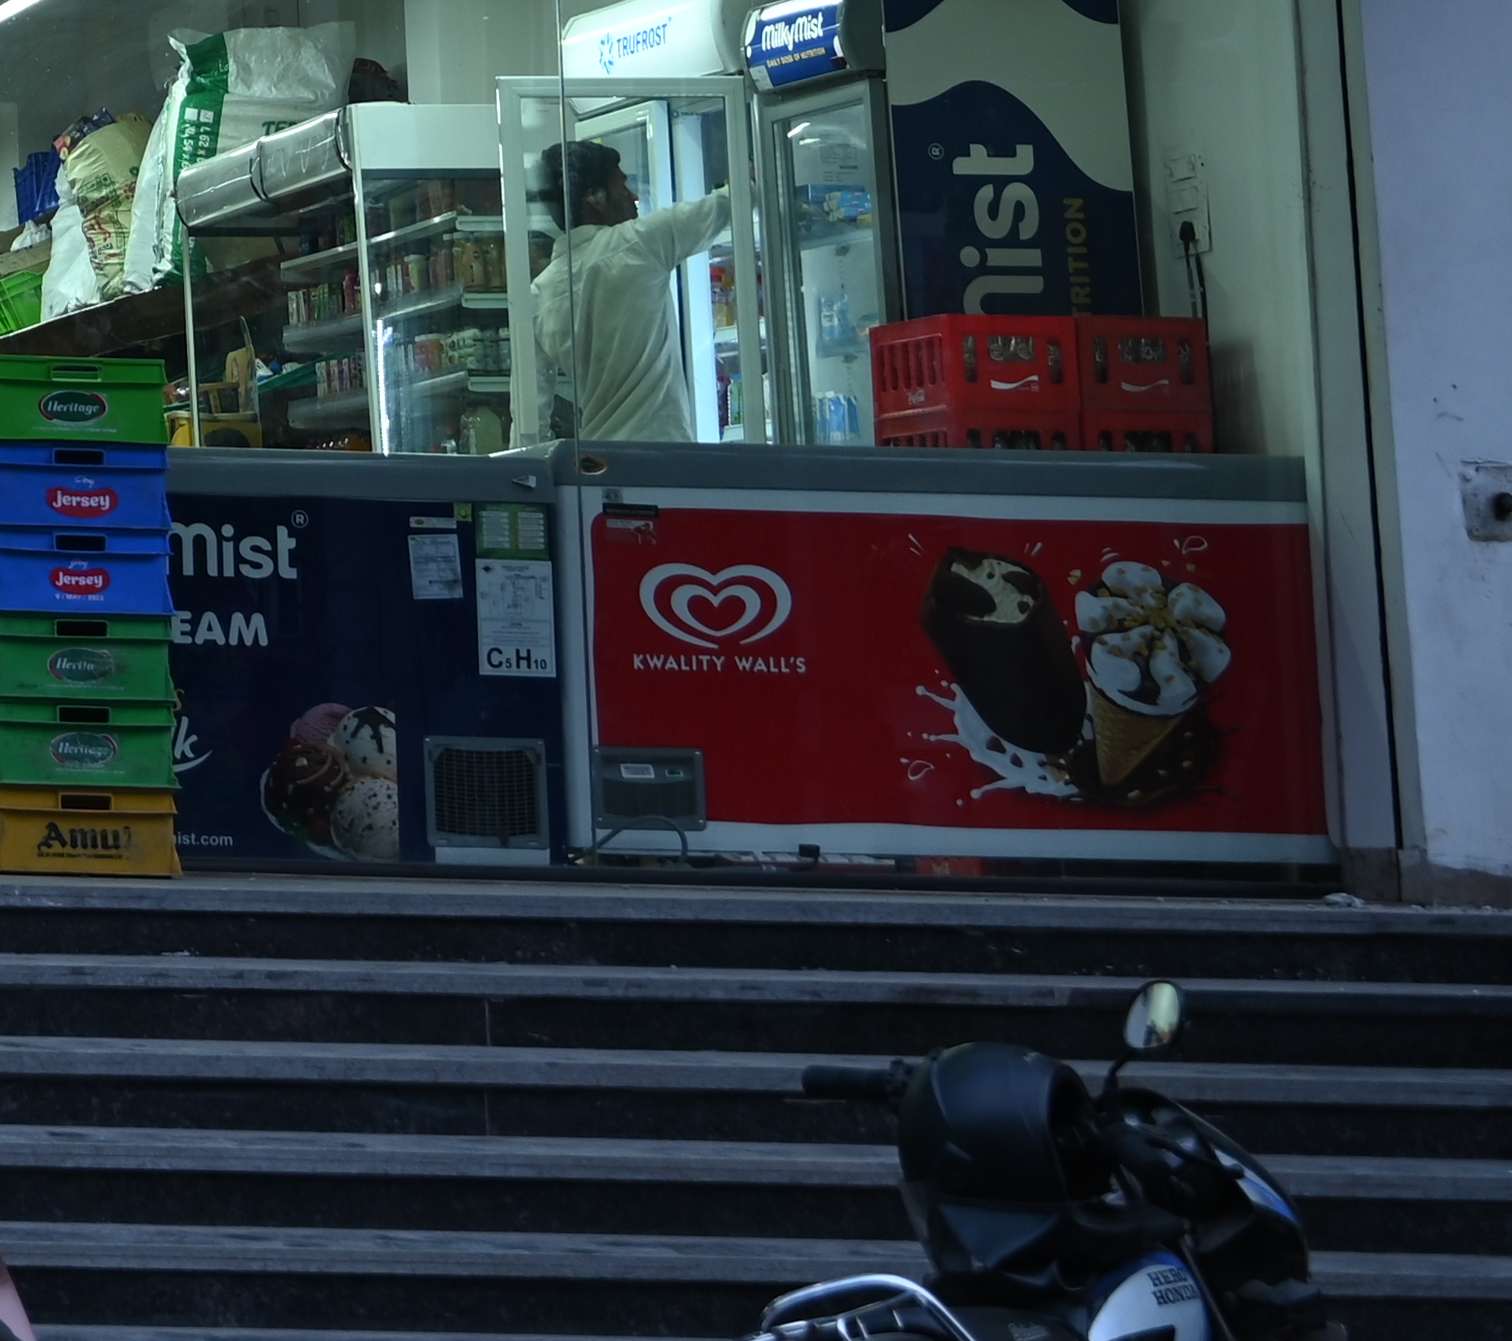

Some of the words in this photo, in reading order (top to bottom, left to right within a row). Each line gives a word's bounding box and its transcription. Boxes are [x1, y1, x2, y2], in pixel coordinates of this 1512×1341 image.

[616, 23, 668, 59] TRUFROST
[761, 11, 825, 52] MilkyMist
[46, 399, 101, 416] Heritage
[52, 489, 112, 512] Jersey
[54, 570, 104, 589] Jersey
[171, 610, 270, 649] EAM
[632, 653, 726, 672] KWALITY
[734, 655, 808, 675] WALL'S
[1146, 1265, 1192, 1287] HERO
[1152, 1283, 1201, 1306] HONDA
